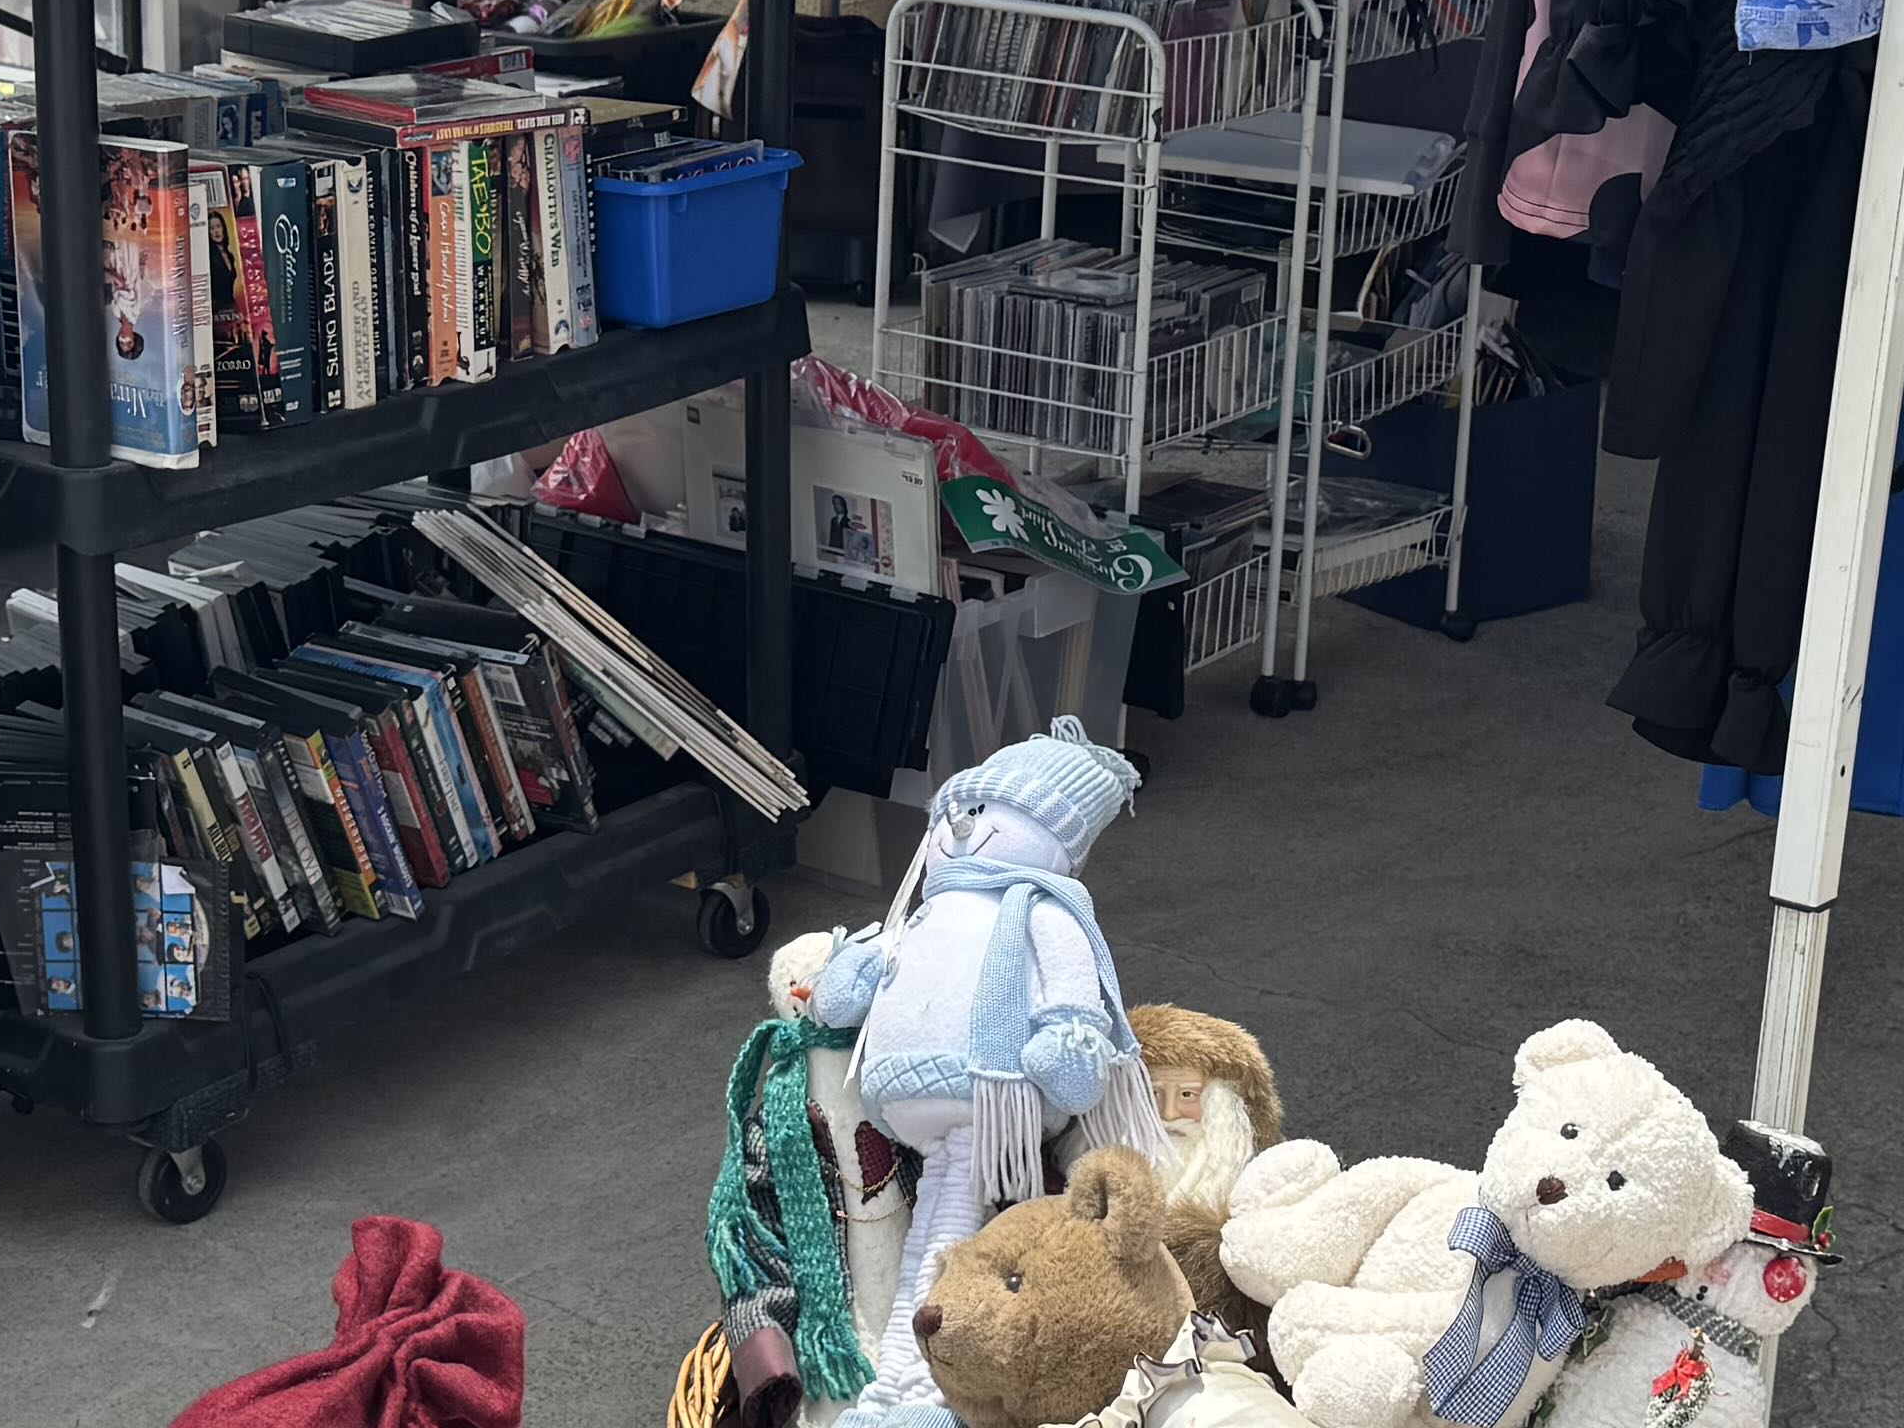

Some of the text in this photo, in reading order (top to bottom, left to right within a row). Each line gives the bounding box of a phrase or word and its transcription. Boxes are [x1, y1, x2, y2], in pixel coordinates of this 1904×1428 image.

[404, 150, 418, 205] Children
[543, 132, 563, 269] CHARLOTTE'S WEB
[408, 207, 419, 227] of
[439, 238, 455, 291] Hardly
[321, 249, 340, 378] SLING BLADE
[350, 281, 362, 312] AND
[476, 264, 487, 347] WORKOUT
[215, 357, 252, 372] ZORRO
[352, 315, 365, 371] OFFICER
[360, 295, 372, 384] GENTLEMAN
